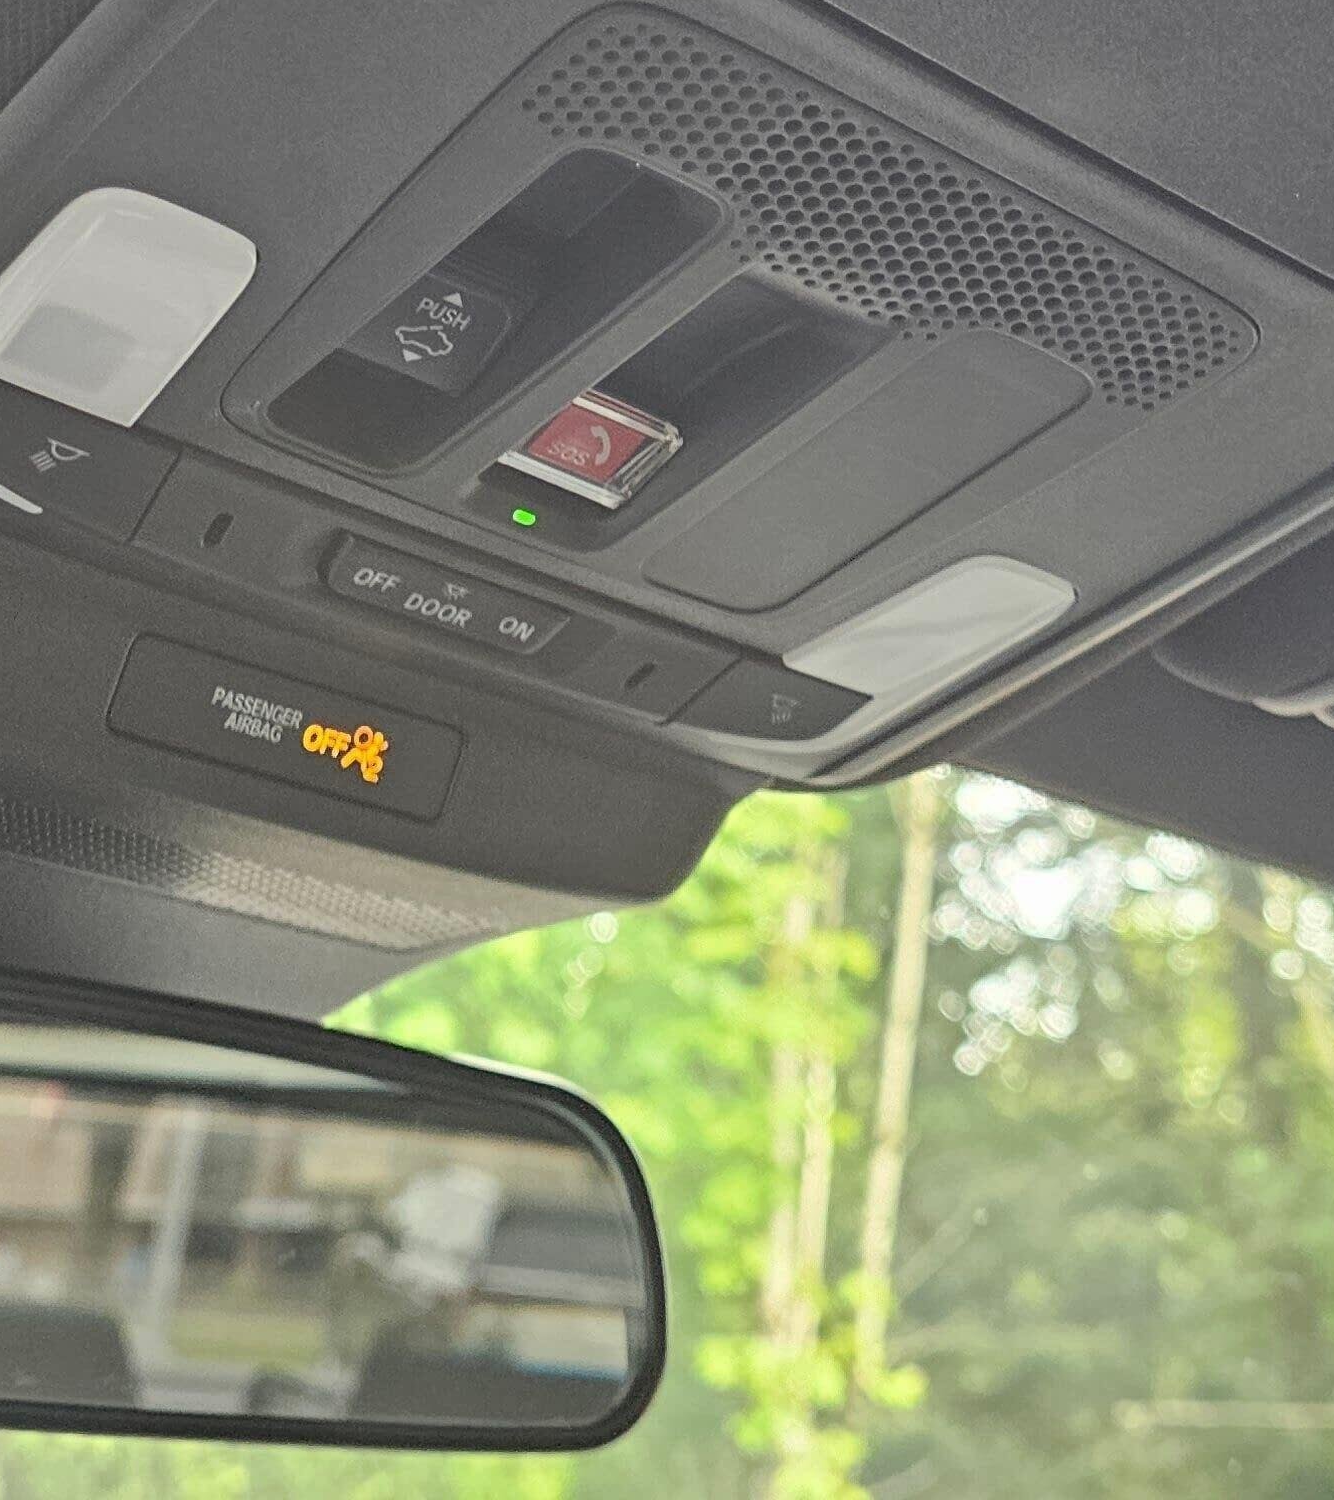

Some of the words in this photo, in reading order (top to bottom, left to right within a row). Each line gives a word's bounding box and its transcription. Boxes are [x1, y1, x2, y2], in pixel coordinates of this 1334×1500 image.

[417, 297, 471, 331] PUSH
[548, 442, 590, 467] SOS
[353, 567, 401, 592] OFF
[403, 592, 473, 628] DOOR
[498, 616, 536, 642] ON
[211, 685, 304, 729] PASSENGER
[223, 711, 284, 743] AIRBAG
[303, 723, 352, 759] OFF
